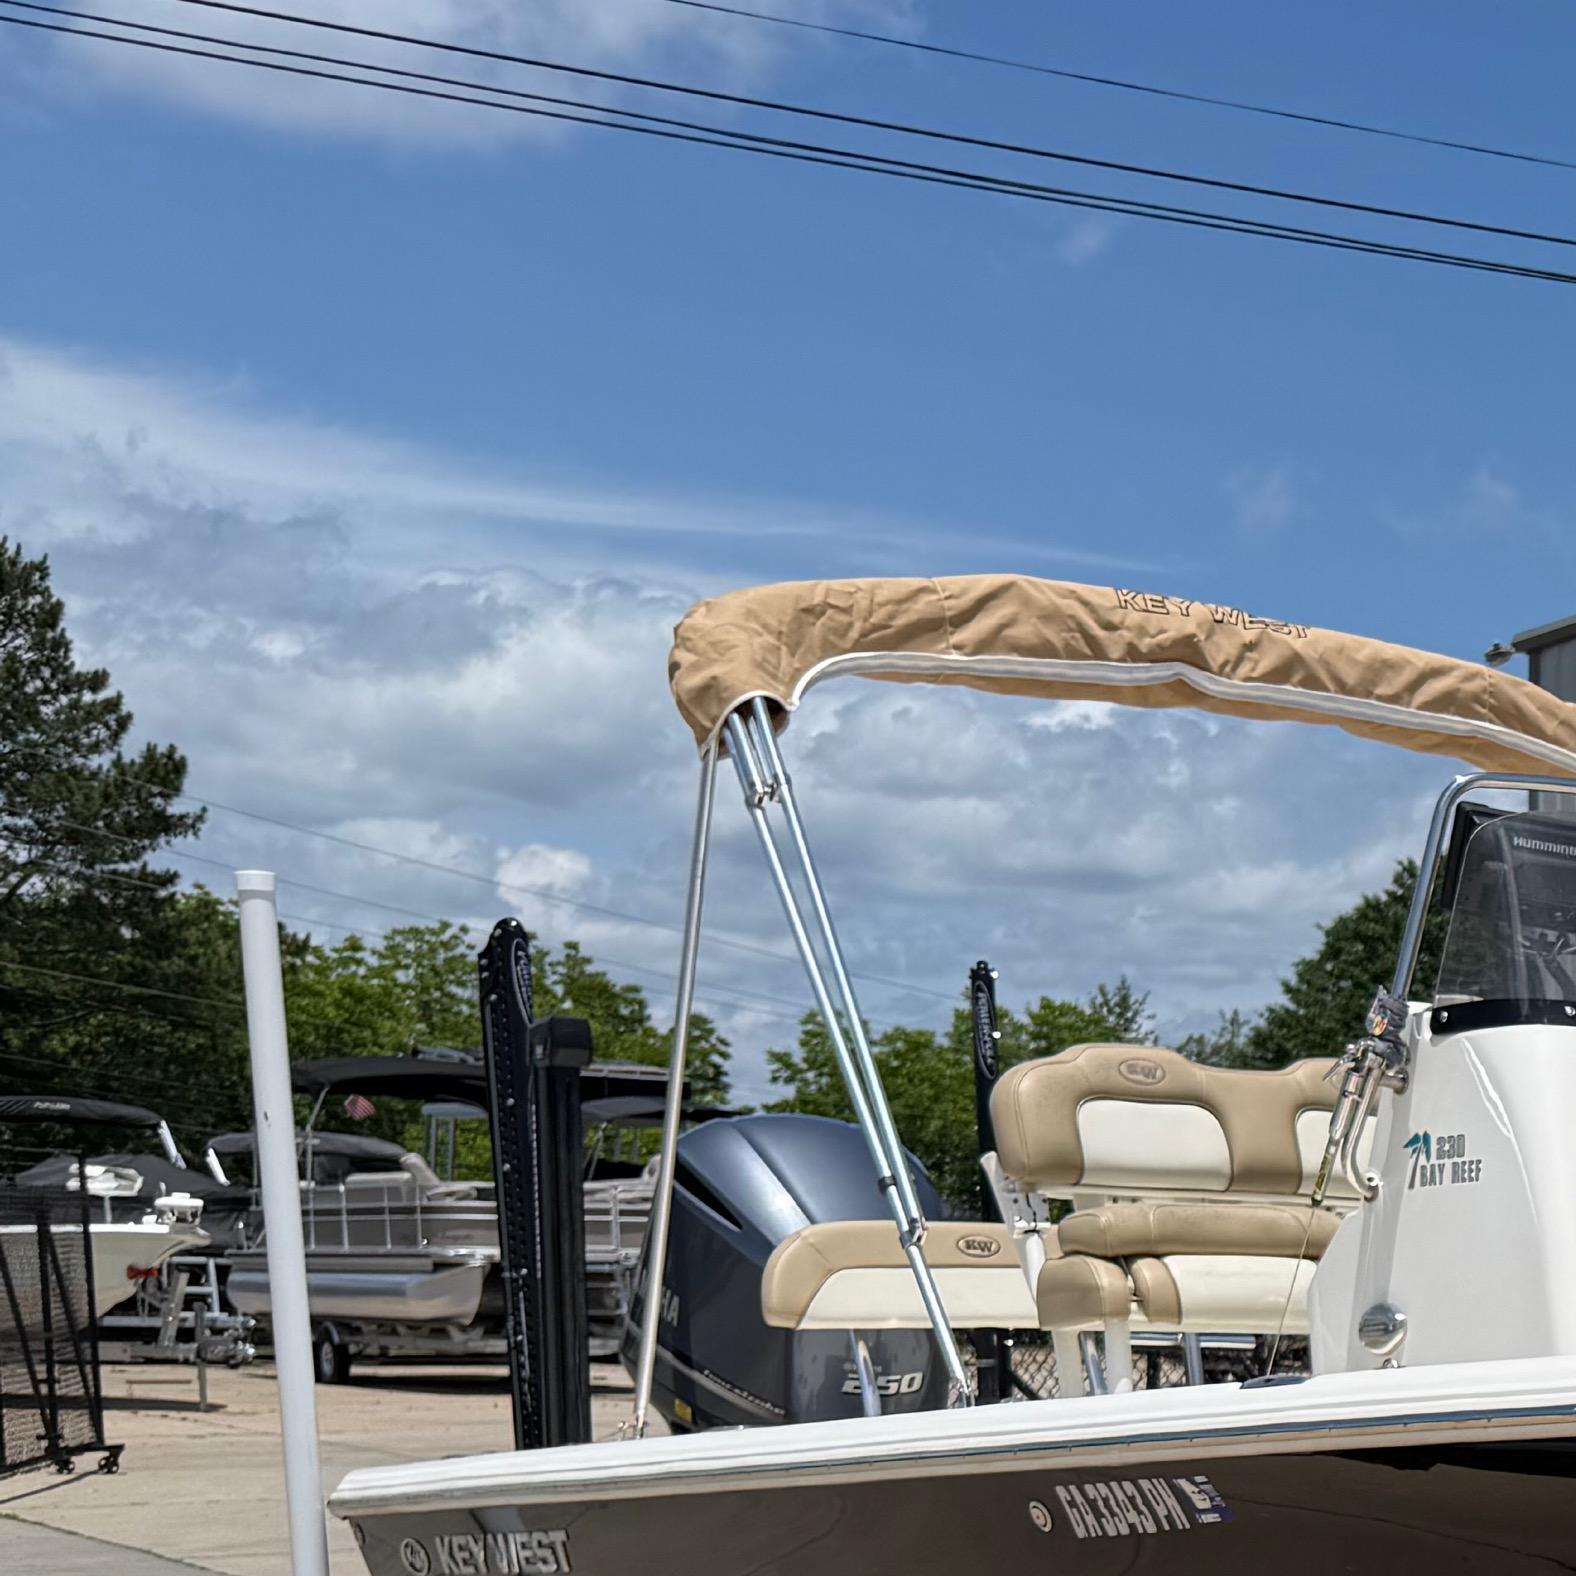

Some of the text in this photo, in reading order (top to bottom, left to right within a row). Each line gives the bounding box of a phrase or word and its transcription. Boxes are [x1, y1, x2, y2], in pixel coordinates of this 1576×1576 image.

[1115, 588, 1192, 617] KEY
[1435, 1133, 1466, 1161] 230
[1419, 1159, 1482, 1187] BAY REEF
[434, 1534, 488, 1575] KEY
[485, 1528, 573, 1574] WEST
